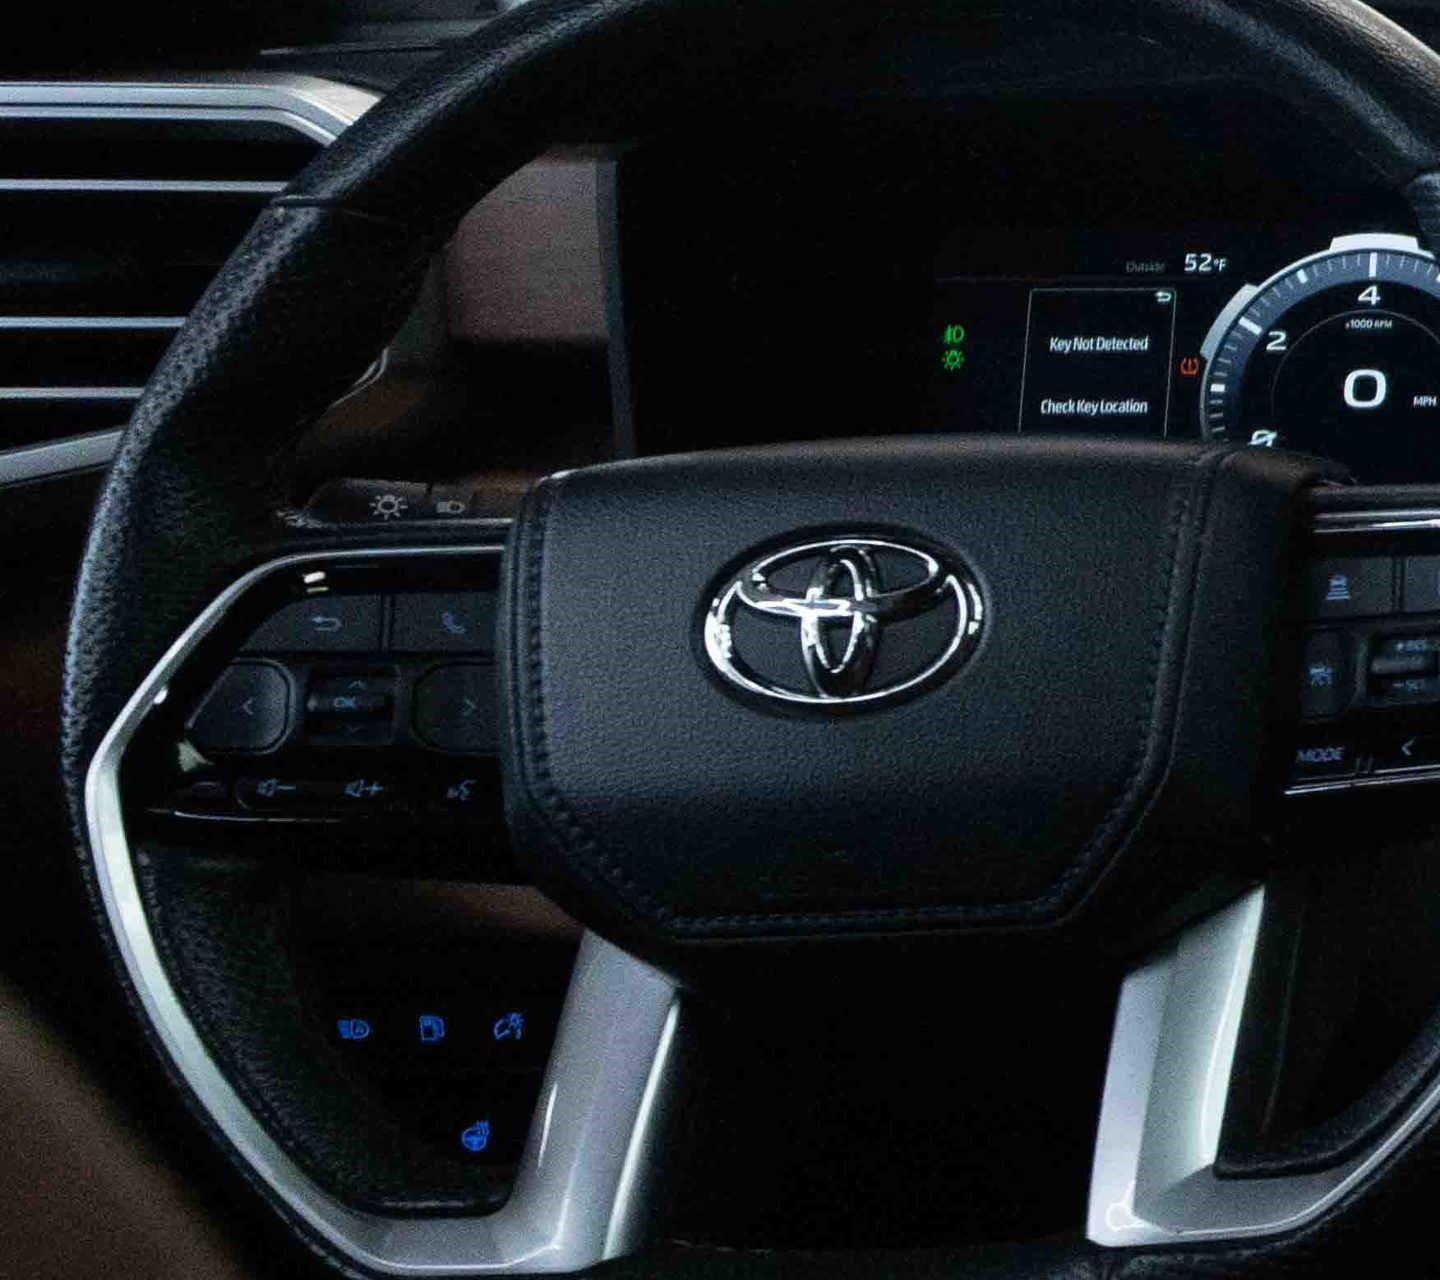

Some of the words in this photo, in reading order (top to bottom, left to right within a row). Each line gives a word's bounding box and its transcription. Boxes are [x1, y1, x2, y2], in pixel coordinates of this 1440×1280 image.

[1357, 285, 1381, 306] 4
[1049, 336, 1072, 354] Key
[1073, 336, 1094, 351] Not
[1095, 335, 1149, 351] Detected
[1265, 330, 1288, 351] 2
[1343, 368, 1388, 409] 0
[1040, 398, 1075, 414] Check
[1076, 398, 1100, 417] Key
[1099, 398, 1149, 414] Location
[1412, 395, 1438, 407] MPH
